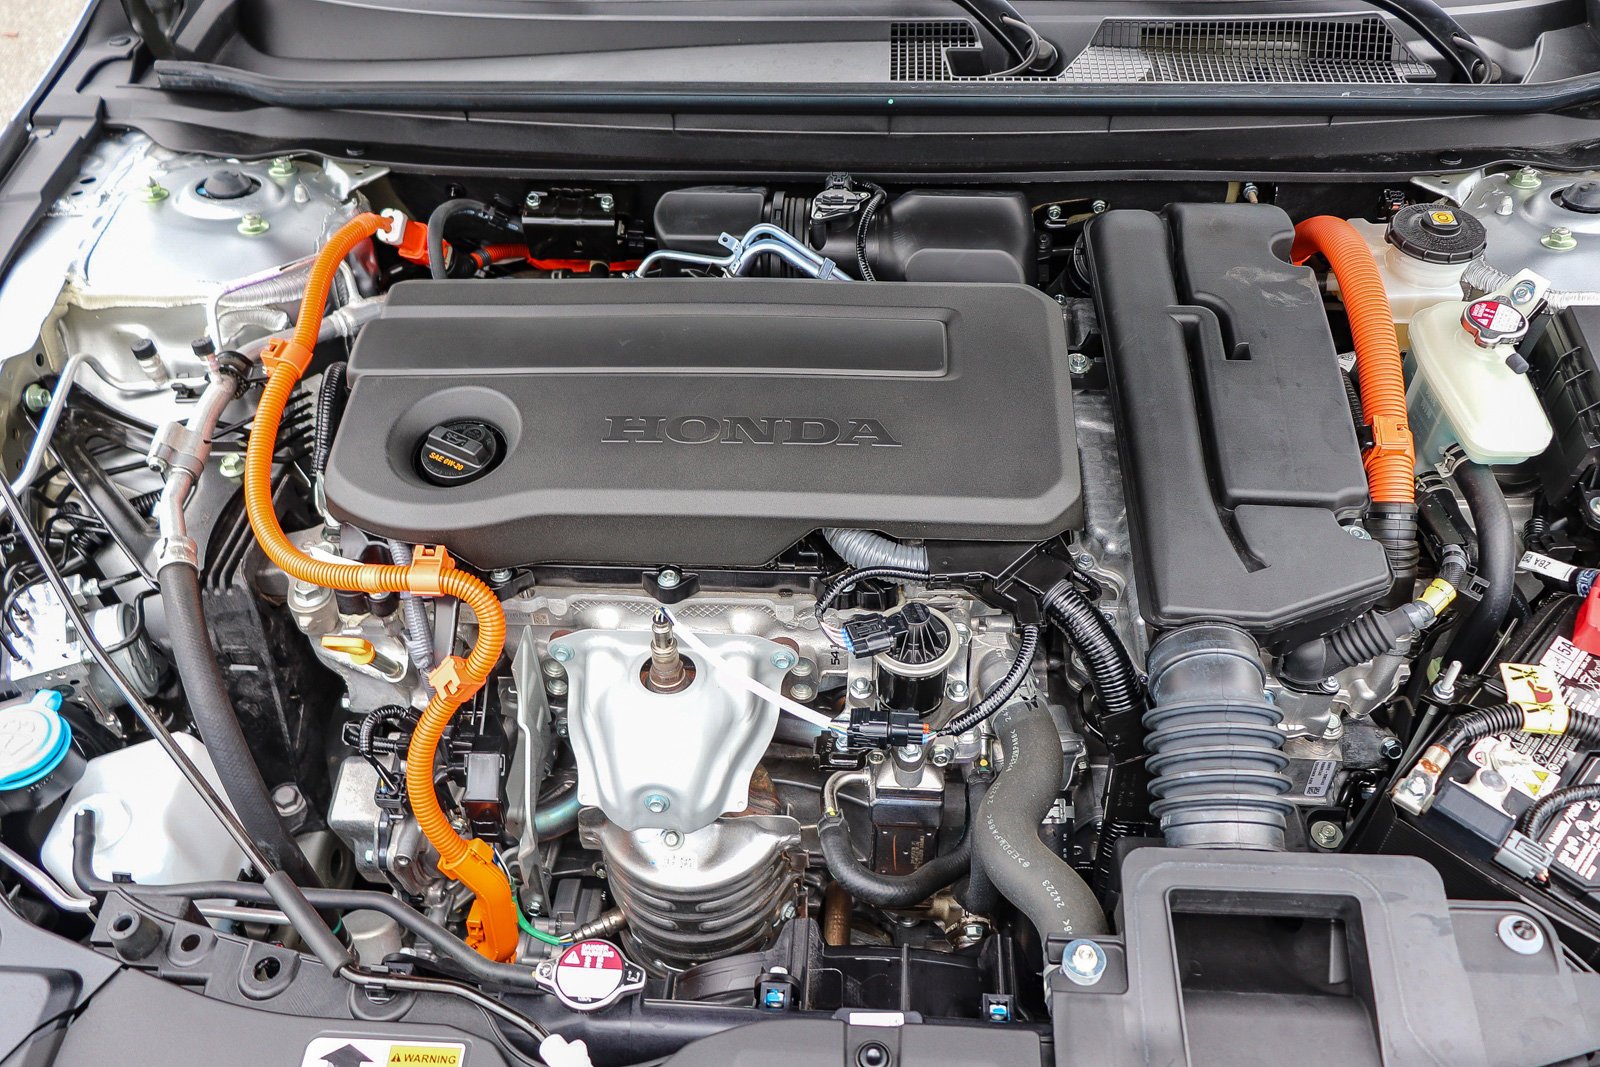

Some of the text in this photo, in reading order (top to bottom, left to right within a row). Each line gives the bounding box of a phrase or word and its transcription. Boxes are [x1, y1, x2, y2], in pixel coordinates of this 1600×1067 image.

[601, 415, 903, 447] HONDA
[429, 451, 464, 471] SAE 0W-20
[1533, 557, 1552, 570] ZBA
[830, 644, 840, 665] 541
[1557, 641, 1575, 656] 5A
[1041, 879, 1065, 909] 24223
[403, 1052, 457, 1064] WARNING
